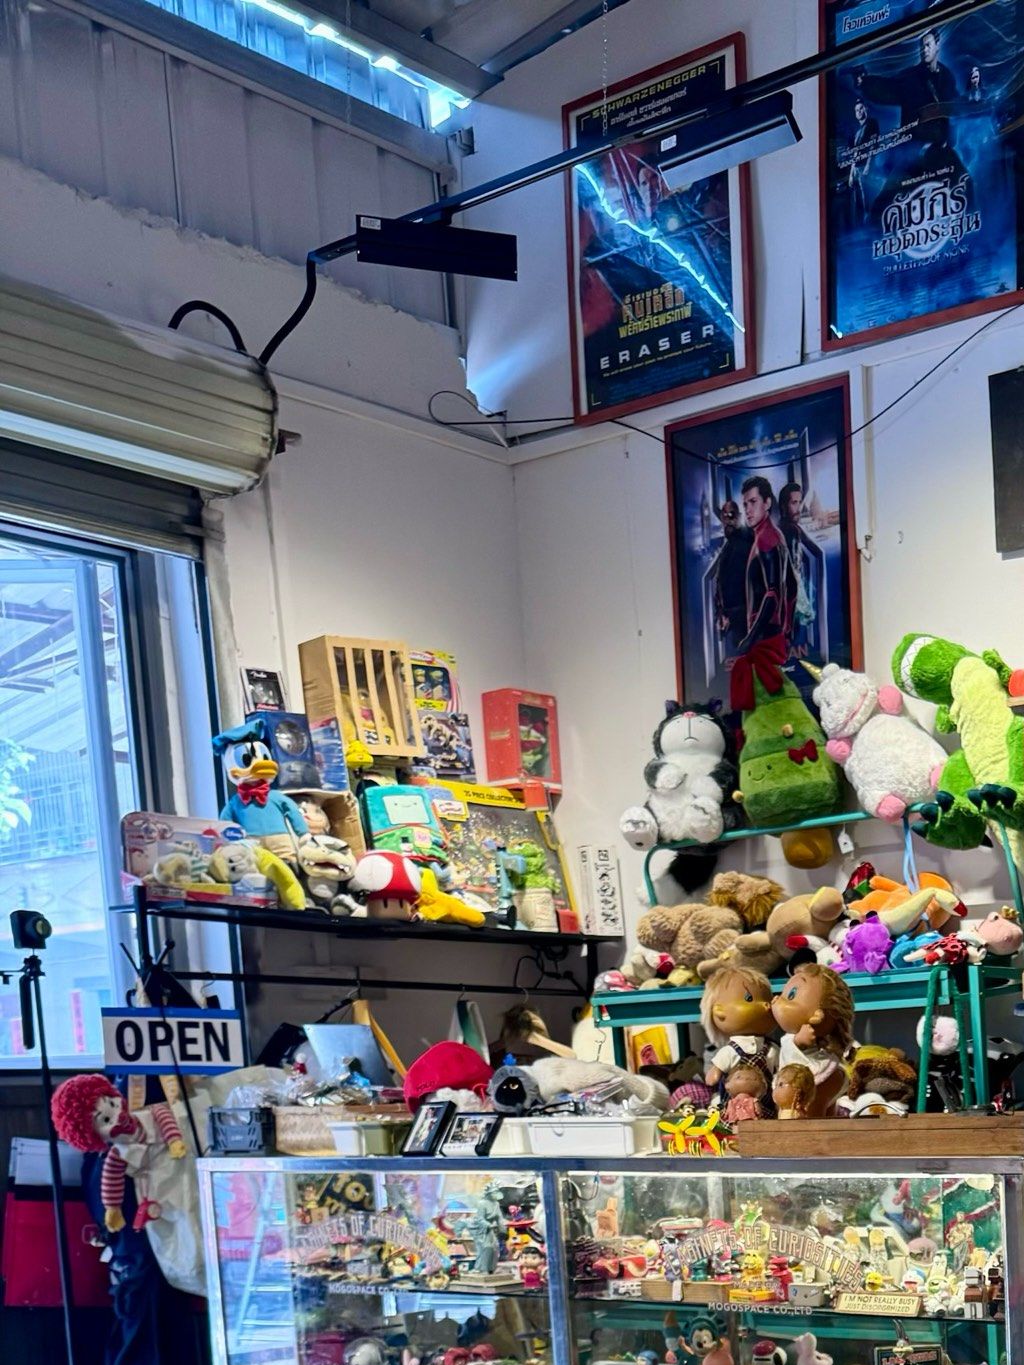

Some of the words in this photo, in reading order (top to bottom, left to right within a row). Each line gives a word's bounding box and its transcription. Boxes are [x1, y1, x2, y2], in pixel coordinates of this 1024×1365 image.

[592, 65, 706, 118] SCHWARZENEGGER
[600, 324, 715, 370] ERASER
[115, 1020, 232, 1063] OPEN
[744, 1226, 762, 1250] OF
[769, 1227, 864, 1292] CURIOSITIES
[708, 1301, 772, 1314] MOGOSPACE
[899, 1298, 916, 1306] BUSY
